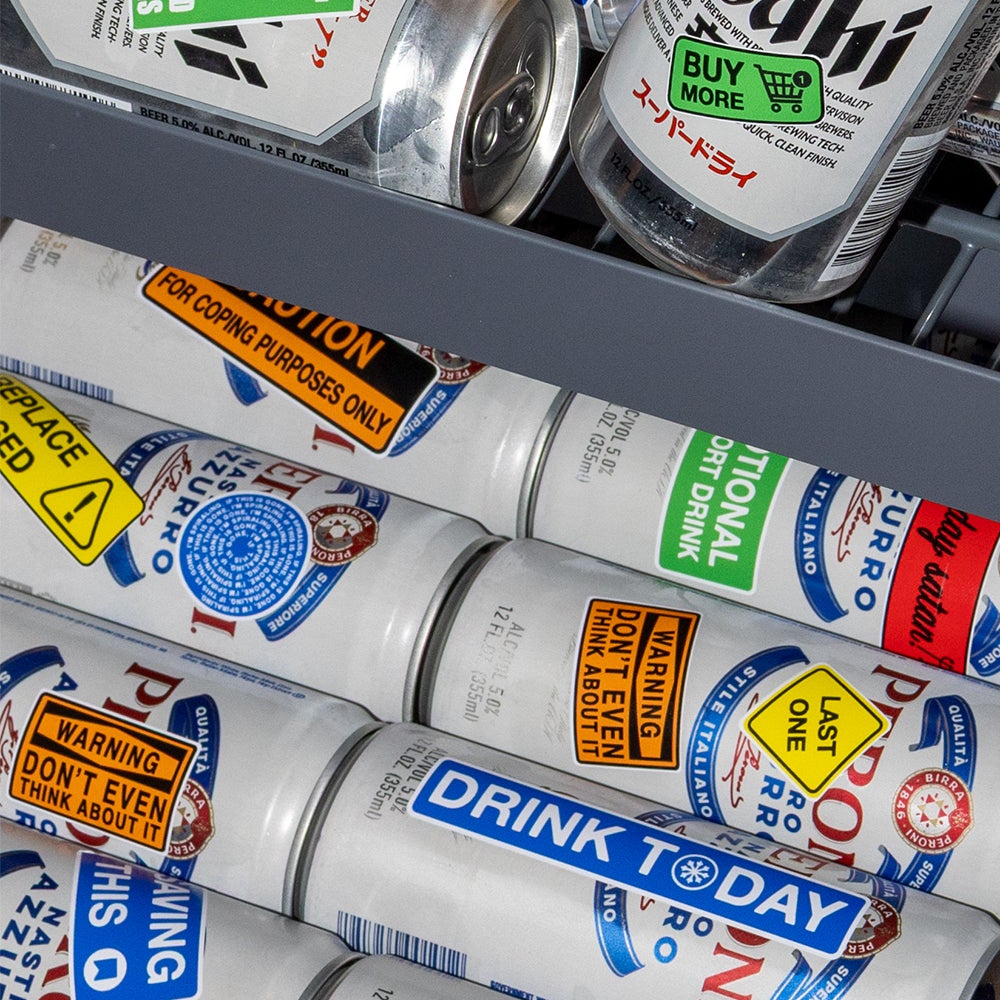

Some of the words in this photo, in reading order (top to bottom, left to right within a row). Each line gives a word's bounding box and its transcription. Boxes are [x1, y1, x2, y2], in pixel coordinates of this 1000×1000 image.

[680, 83, 745, 111] MORE
[683, 50, 745, 86] BUY
[633, 77, 758, 188] スーパードライ
[774, 138, 806, 158] CLEAN
[157, 271, 197, 304] FOR
[193, 295, 259, 346] COPING
[254, 335, 344, 406] PURPOSES
[342, 393, 393, 435] ONLY
[599, 446, 621, 476] 5.0%
[336, 507, 372, 529] BIRRA
[678, 482, 715, 563] DRINK
[802, 482, 831, 575] ITALIANO
[267, 572, 328, 633] SUPERIORE
[585, 608, 613, 656] THINK
[612, 609, 641, 679] DON'T
[579, 664, 602, 729] ABOUT
[638, 630, 675, 739] WARNING
[710, 667, 757, 715] STILE
[56, 719, 161, 775] WARNING
[581, 734, 599, 757] IT
[599, 690, 627, 761] EVEN
[787, 699, 810, 753] ONE
[816, 695, 842, 757] LAST
[948, 705, 969, 767] QUALITÀ
[22, 749, 98, 796] DON'T
[102, 778, 168, 823] EVEN
[694, 721, 716, 818] ITALIANO
[924, 773, 965, 802] BIRRA
[20, 777, 73, 812] THINK
[76, 799, 137, 834] ABOUT
[143, 822, 161, 843] IT
[429, 772, 626, 862] DRINK
[895, 783, 915, 820] 1846
[905, 828, 953, 848] PERONI
[88, 862, 133, 928] THIS
